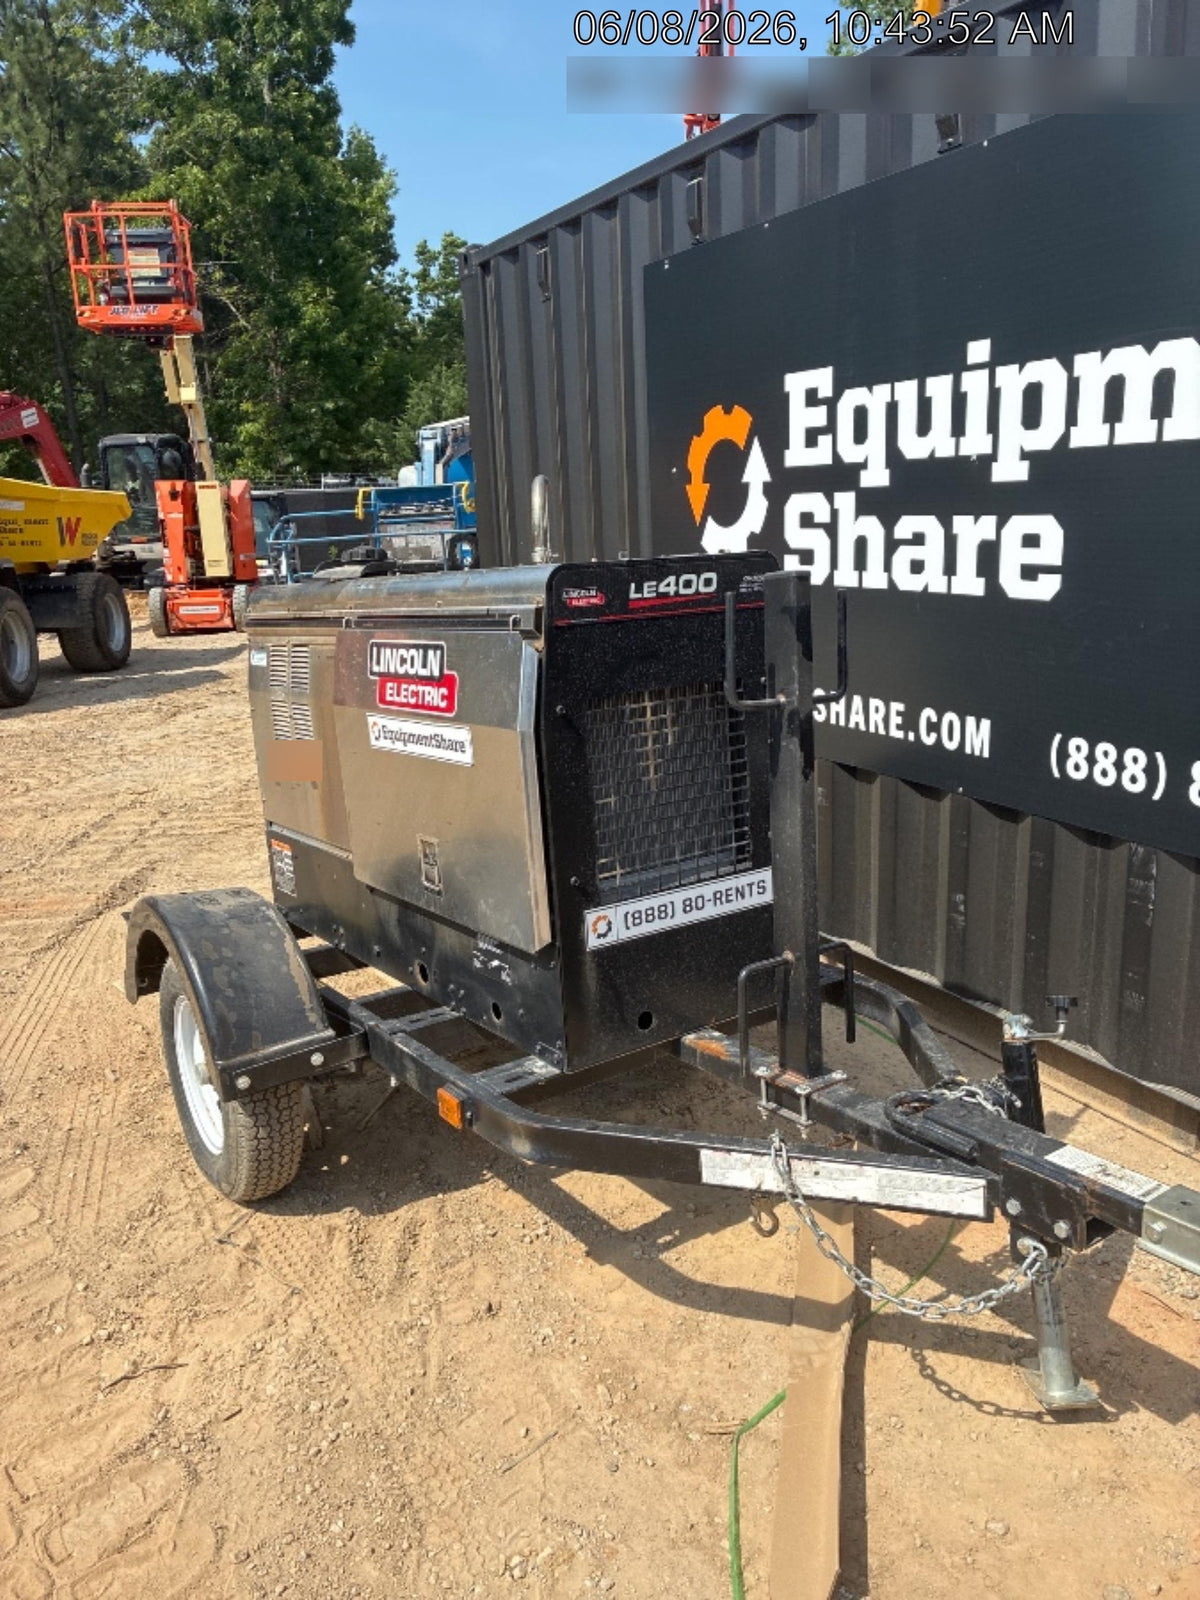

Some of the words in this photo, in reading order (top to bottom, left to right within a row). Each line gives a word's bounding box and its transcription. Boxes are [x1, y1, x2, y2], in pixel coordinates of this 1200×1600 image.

[783, 337, 1200, 488] Equipm
[783, 491, 1064, 602] Share
[628, 571, 718, 599] LE400
[372, 645, 442, 678] LINCOLN
[385, 681, 449, 709] ELECTRIC
[381, 723, 467, 754] EquipmentShare
[1050, 733, 1168, 801] (888)
[623, 900, 675, 930] (888)
[682, 879, 767, 915] 80-RENTS
